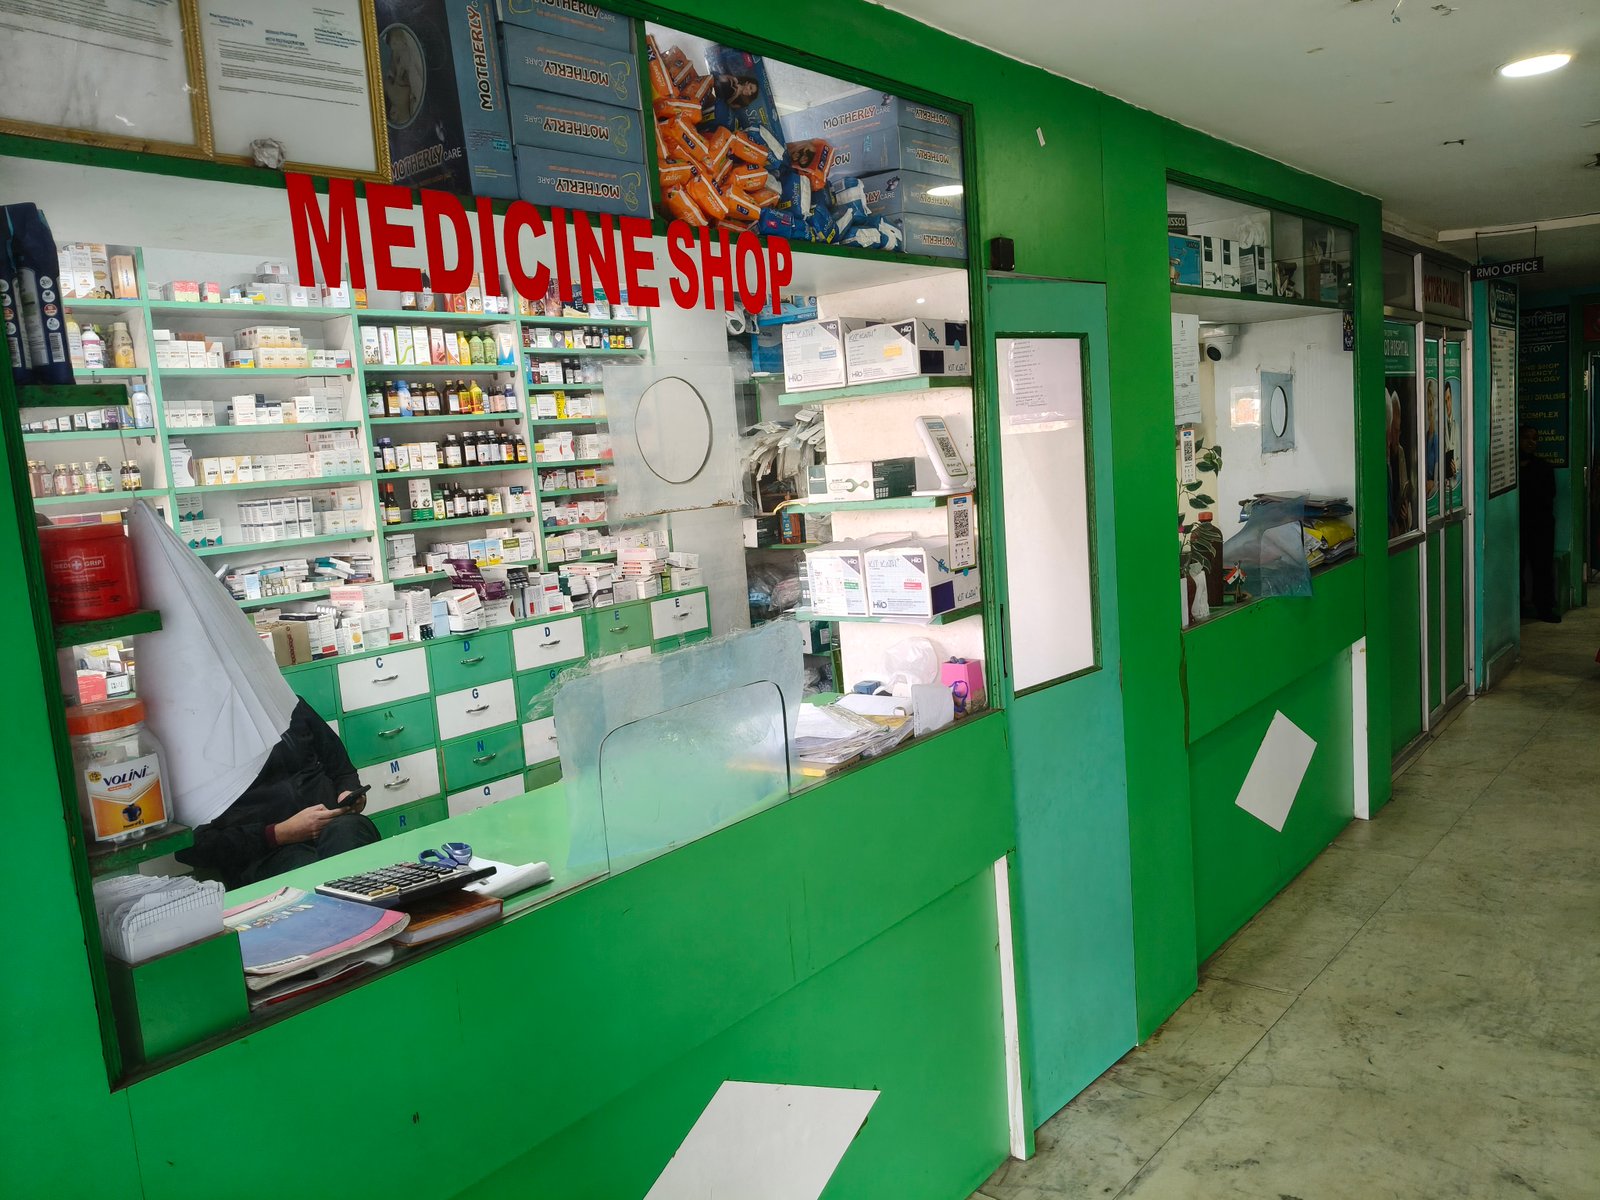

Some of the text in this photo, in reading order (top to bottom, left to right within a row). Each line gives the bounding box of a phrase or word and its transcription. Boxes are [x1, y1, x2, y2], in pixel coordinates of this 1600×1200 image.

[600, 12, 616, 23] CARE
[467, 5, 494, 111] MOTHERLY
[525, 56, 543, 67] CARE
[543, 60, 609, 87] MOTHERLY
[823, 105, 876, 131] MOTHERLY
[876, 105, 891, 114] CARE
[915, 108, 950, 126] MOTHERLY
[524, 114, 609, 141] MOTHERLY CARE
[916, 149, 950, 164] MOTHERLY
[392, 144, 443, 182] MOTHERLY
[443, 147, 462, 161] CARE
[537, 175, 621, 199] MOTHERLY CARE
[880, 191, 895, 201] CARE
[285, 172, 793, 316] MEDICINE SHOP
[922, 234, 956, 247] MOTHERLY
[1476, 260, 1538, 278] RMO OFFICE
[84, 559, 102, 567] GRIP
[674, 598, 681, 608] E
[614, 610, 620, 621] E
[544, 626, 551, 638] D
[464, 640, 471, 652] D
[375, 657, 384, 669] C
[549, 669, 556, 680] G
[472, 688, 479, 700] G
[477, 740, 485, 753] N
[390, 760, 400, 774] M
[483, 786, 491, 796] Q
[399, 815, 407, 827] R
